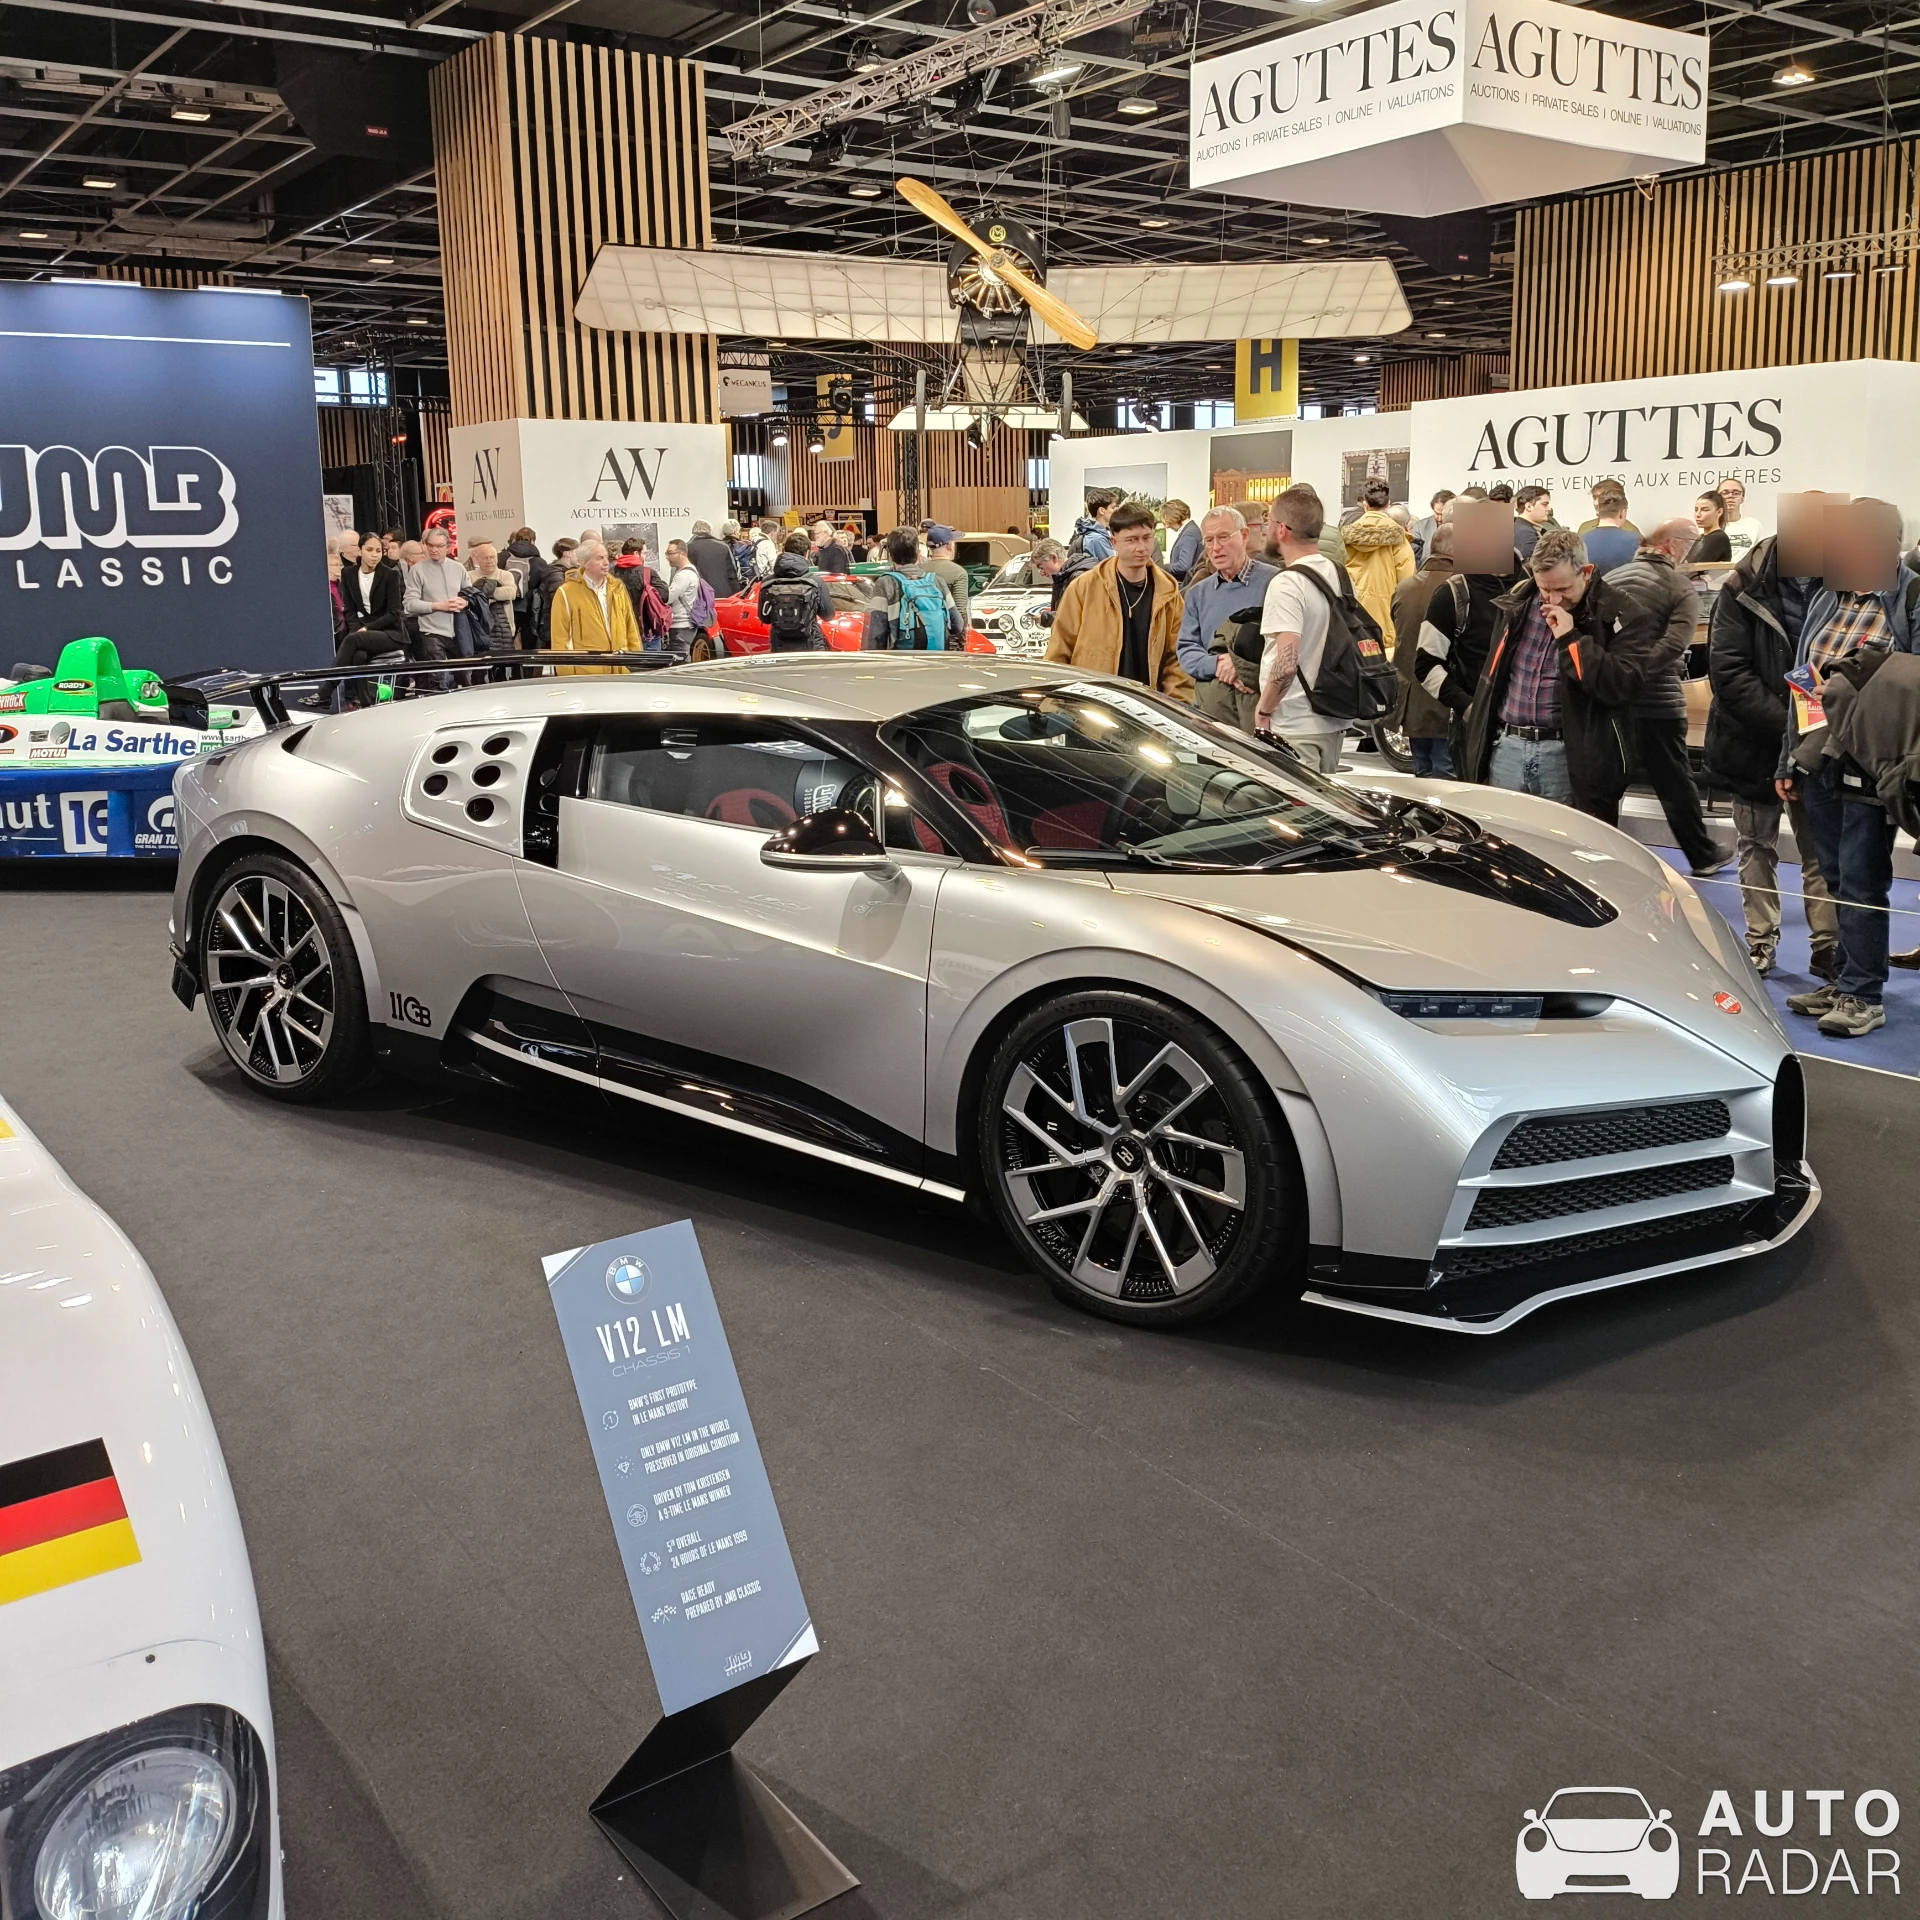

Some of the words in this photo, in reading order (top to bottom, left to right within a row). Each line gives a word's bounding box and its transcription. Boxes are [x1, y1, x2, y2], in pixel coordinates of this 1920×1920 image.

[1196, 10, 1457, 138] AGUTTES
[1471, 12, 1704, 110] AGUTTES
[1196, 139, 1241, 162] AUCTIONS
[1252, 125, 1290, 146] PRIVATE
[1291, 116, 1323, 136] SALES
[1335, 103, 1374, 124] ONLINE
[1387, 83, 1455, 110] VALUATIONS
[1469, 83, 1520, 103] AUCTIONS
[1532, 93, 1569, 112] PRIVATE
[1570, 101, 1600, 118] SALES
[1610, 109, 1642, 126] ONLINE
[1652, 116, 1702, 136] VALUATIONS
[1249, 338, 1283, 394] H
[1467, 398, 1782, 472] AGUTTES
[470, 446, 501, 504] AW
[587, 446, 669, 502] AW
[1534, 478, 1555, 490] DE
[1633, 472, 1670, 488] AUX
[1678, 466, 1782, 487] ENCHÈRES
[465, 511, 488, 522] AGUTTES
[493, 508, 516, 521] WHEELS
[570, 508, 628, 519] AGUTTES
[640, 507, 691, 518] WHEELS
[16, 555, 233, 589] LASSIC
[30, 748, 66, 758] MOTUL
[67, 728, 97, 750] La
[105, 730, 197, 756] Sarthe
[135, 833, 163, 844] GRAN
[608, 1257, 645, 1276] BMW
[596, 1316, 646, 1363] V12
[651, 1302, 691, 1347] LM
[612, 1348, 681, 1377] CHASSIS
[684, 1344, 691, 1354] 1
[628, 1395, 650, 1411] BMW'S
[648, 1388, 666, 1404] FIRST
[665, 1379, 698, 1399] PROTOTYPE
[632, 1413, 641, 1426] IN
[640, 1411, 649, 1424] LE
[647, 1405, 666, 1421] MANS
[664, 1397, 689, 1415] HISTORY
[640, 1446, 656, 1459] ONLY
[655, 1440, 671, 1454] BMW
[670, 1436, 683, 1449] V12
[682, 1432, 692, 1446] LM
[690, 1430, 699, 1441] IN
[698, 1425, 711, 1439] THE
[709, 1418, 730, 1436] WORLD
[644, 1453, 678, 1474] PRESERVED
[677, 1451, 686, 1463] IN
[684, 1443, 711, 1460] ORIGINAL
[711, 1432, 740, 1451] CONDITION
[652, 1491, 675, 1506] DRIVEN
[674, 1487, 683, 1498] BY
[682, 1481, 697, 1496] TOM
[695, 1468, 731, 1491] KRISTENSEN
[658, 1510, 664, 1522] A
[663, 1503, 684, 1519] 9-TIME
[682, 1498, 692, 1512] LE
[690, 1493, 709, 1509] MANS
[708, 1484, 732, 1503] WINNER
[670, 1556, 680, 1569] 24
[679, 1548, 700, 1565] HOURS
[699, 1545, 709, 1558] OF
[707, 1542, 717, 1554] LE
[715, 1535, 734, 1552] MANS
[732, 1529, 748, 1545] 1999
[674, 1530, 702, 1550] OVERALL
[680, 1588, 698, 1604] RACE
[696, 1580, 716, 1598] READY
[684, 1598, 716, 1620] PREPARED
[714, 1595, 724, 1609] BY
[724, 1590, 738, 1605] JMB
[737, 1580, 762, 1599] CLASSIC
[726, 1662, 753, 1677] CLASSIC
